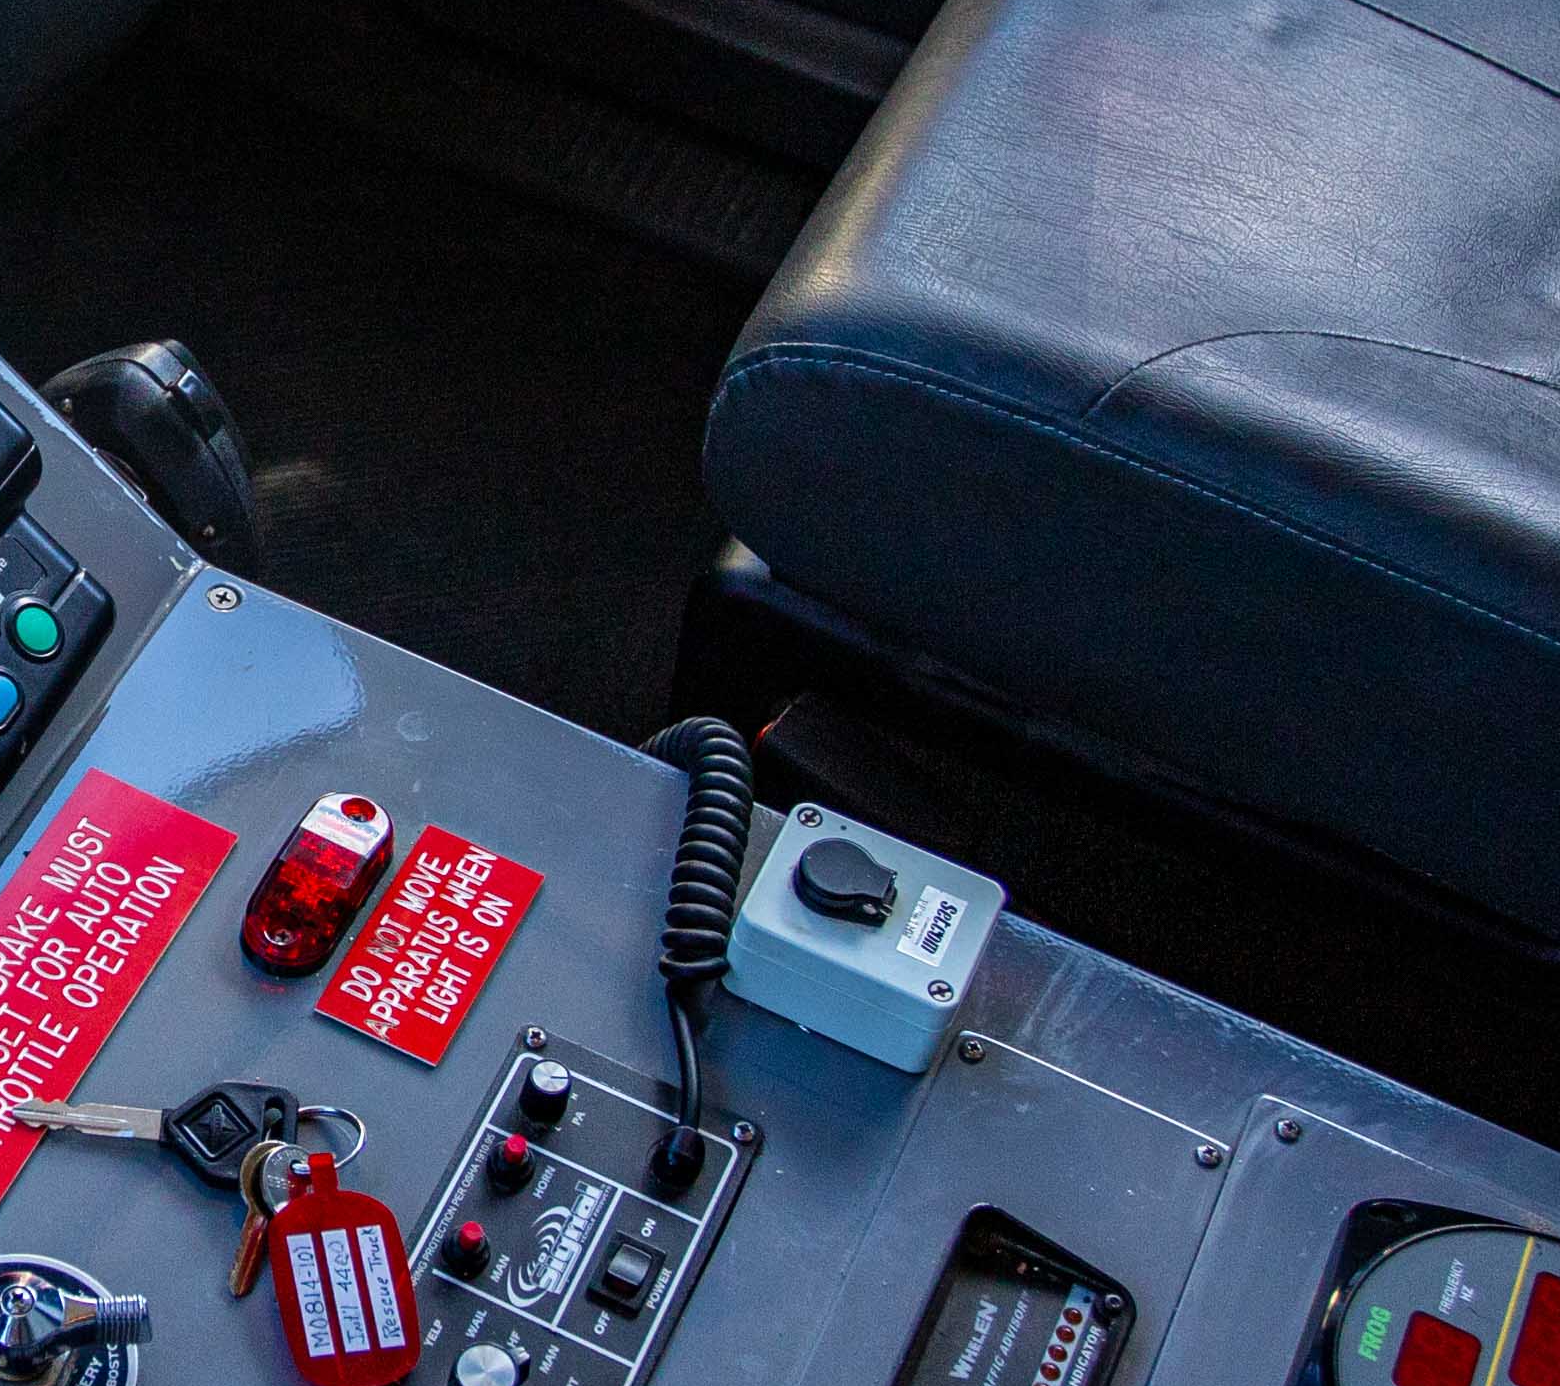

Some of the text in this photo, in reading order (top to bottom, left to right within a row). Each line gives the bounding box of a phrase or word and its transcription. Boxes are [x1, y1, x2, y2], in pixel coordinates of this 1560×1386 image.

[41, 816, 113, 894] MUST
[16, 936, 80, 1001] FOR
[65, 861, 131, 935] AUTO
[62, 855, 185, 1009] OPERATION
[340, 851, 452, 1003] DO NOT MOVE
[363, 844, 498, 1041] APPARATUS WHEN
[920, 900, 958, 954] Setcom
[413, 891, 514, 1025] LIGHT IS ON
[572, 1110, 586, 1127] PA
[532, 1164, 557, 1200] HORN
[422, 1206, 459, 1263] PROTECTION
[452, 1185, 468, 1210] PER
[461, 1162, 480, 1188] OSHA
[640, 1218, 657, 1238] ON
[489, 1254, 511, 1283] MAN
[646, 1267, 673, 1310] POWER
[1437, 1256, 1466, 1316] FREQUENCY
[1458, 1284, 1475, 1303] HZ
[377, 1276, 402, 1340] Rescue
[423, 1318, 444, 1349] YELP
[464, 1308, 488, 1339] WAIL
[593, 1310, 611, 1336] OFF
[1357, 1304, 1393, 1362] FROG
[506, 1330, 521, 1349] HF
[539, 1344, 561, 1375] MAN
[949, 1299, 999, 1381] WHELEN
